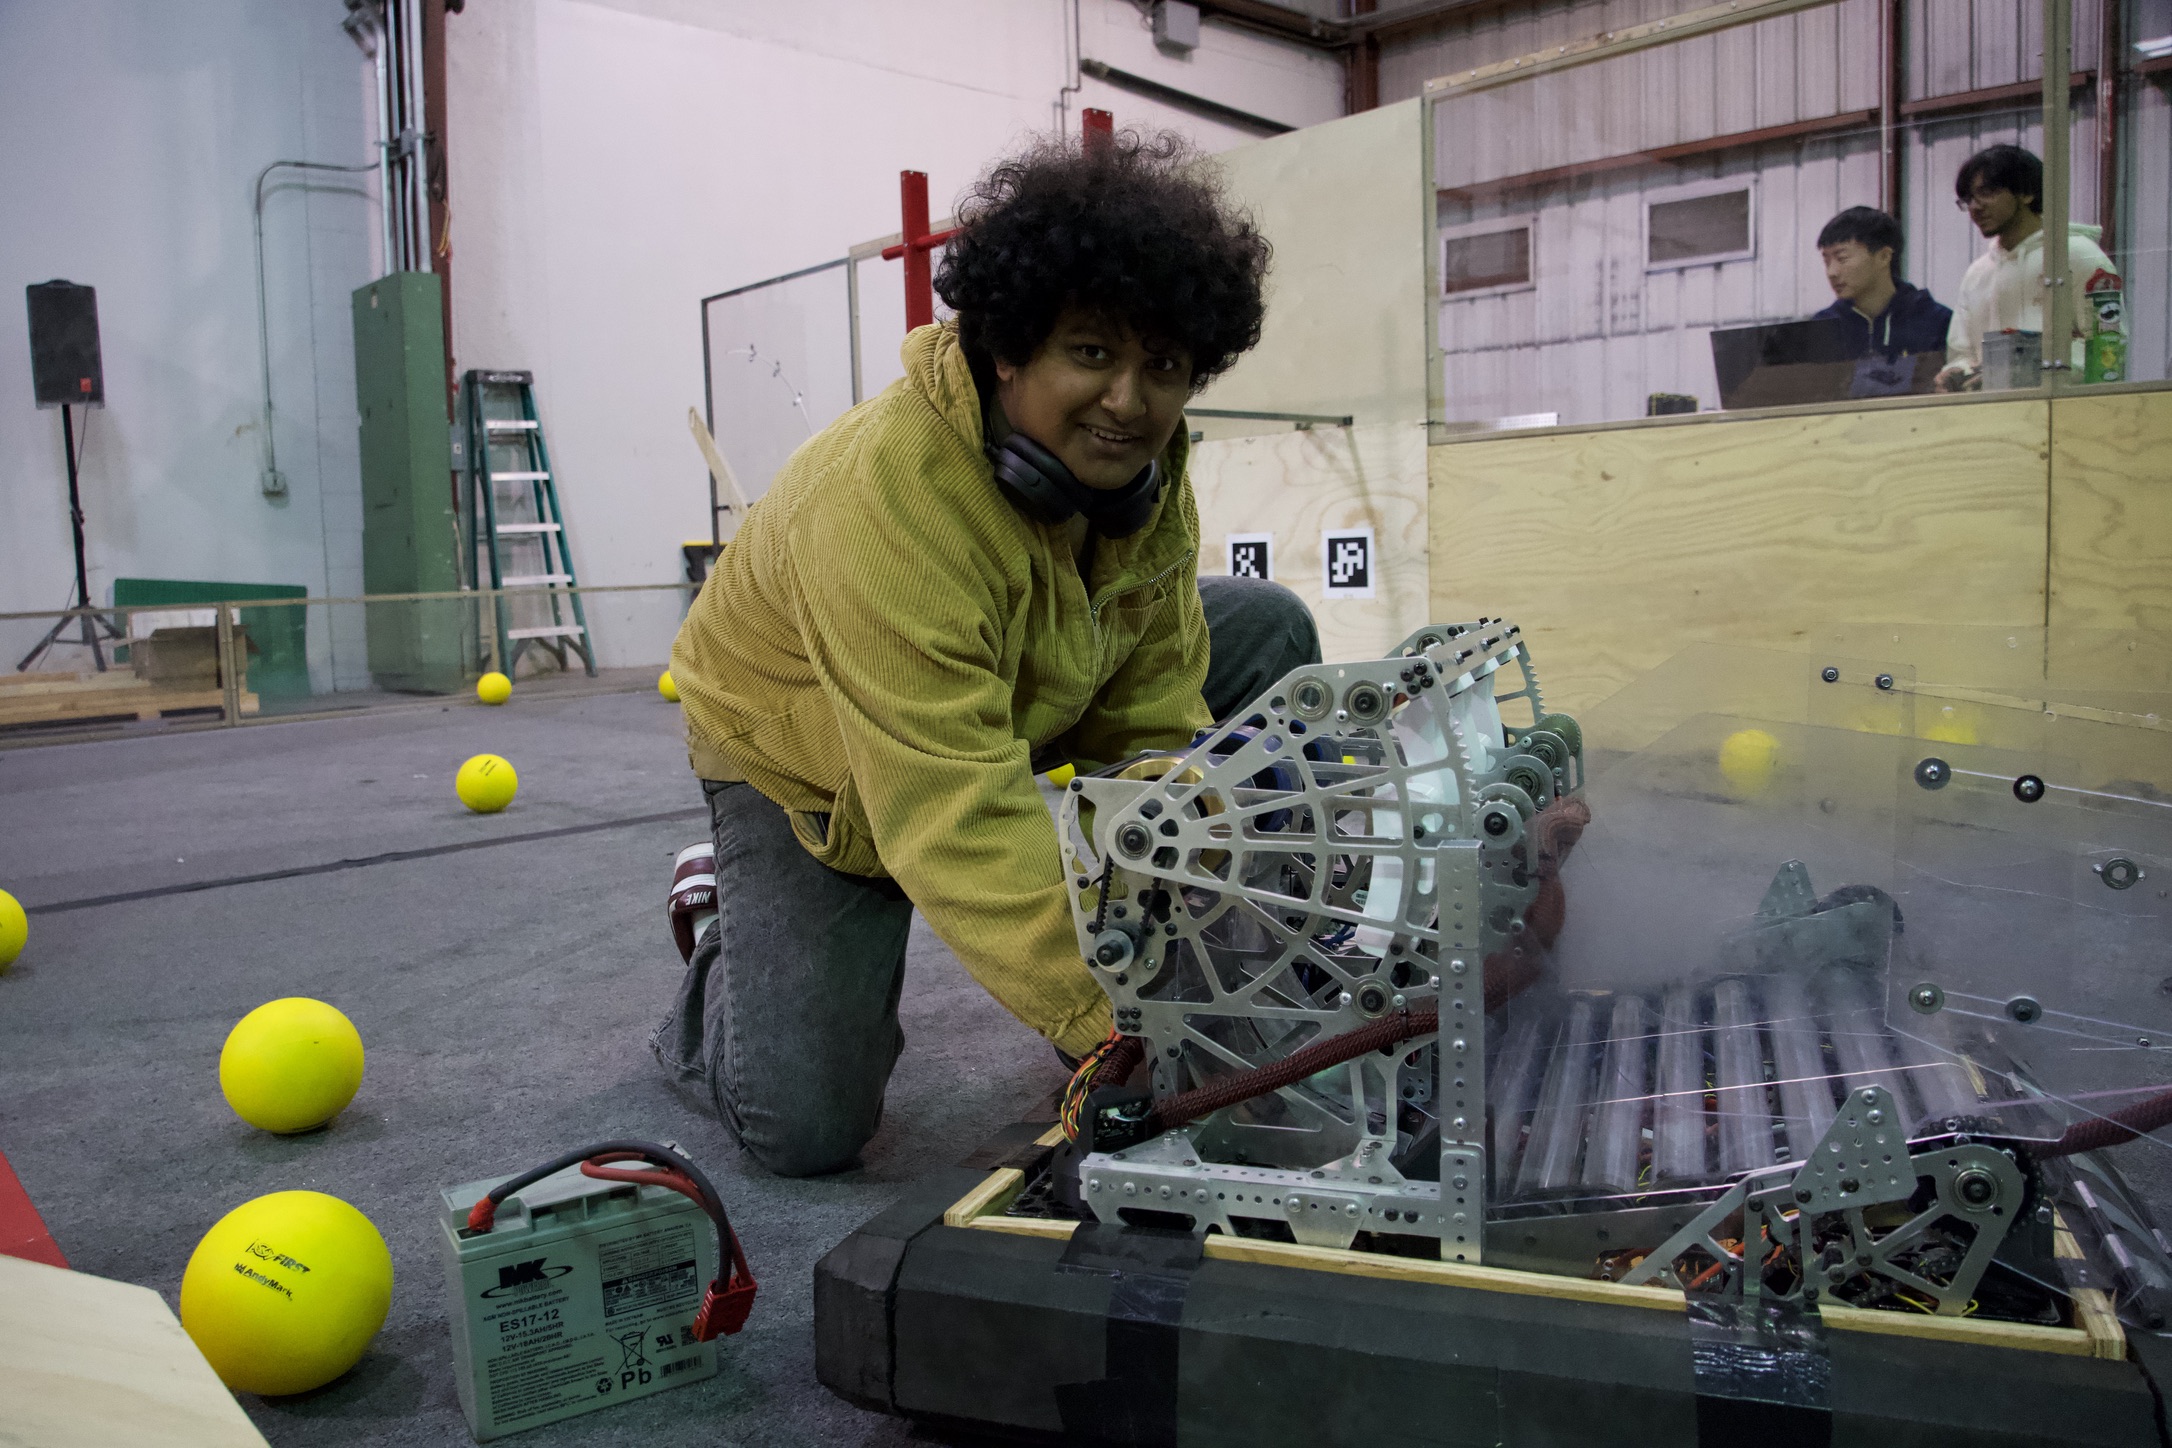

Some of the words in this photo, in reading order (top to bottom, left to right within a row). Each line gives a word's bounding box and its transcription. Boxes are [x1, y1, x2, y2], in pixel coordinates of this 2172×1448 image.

[686, 891, 711, 906] NIKE
[273, 1254, 311, 1274] FIRST
[499, 1257, 549, 1290] MK
[243, 1268, 293, 1298] AndyMark
[496, 1289, 562, 1310] www.mkbattery.com
[545, 1297, 569, 1306] BATTERY
[500, 1308, 560, 1333] ES17-12
[501, 1321, 564, 1343] 12V-15.3AH/5HR
[503, 1332, 563, 1352] 12V-18AH/20HR
[621, 1366, 652, 1390] Pb
